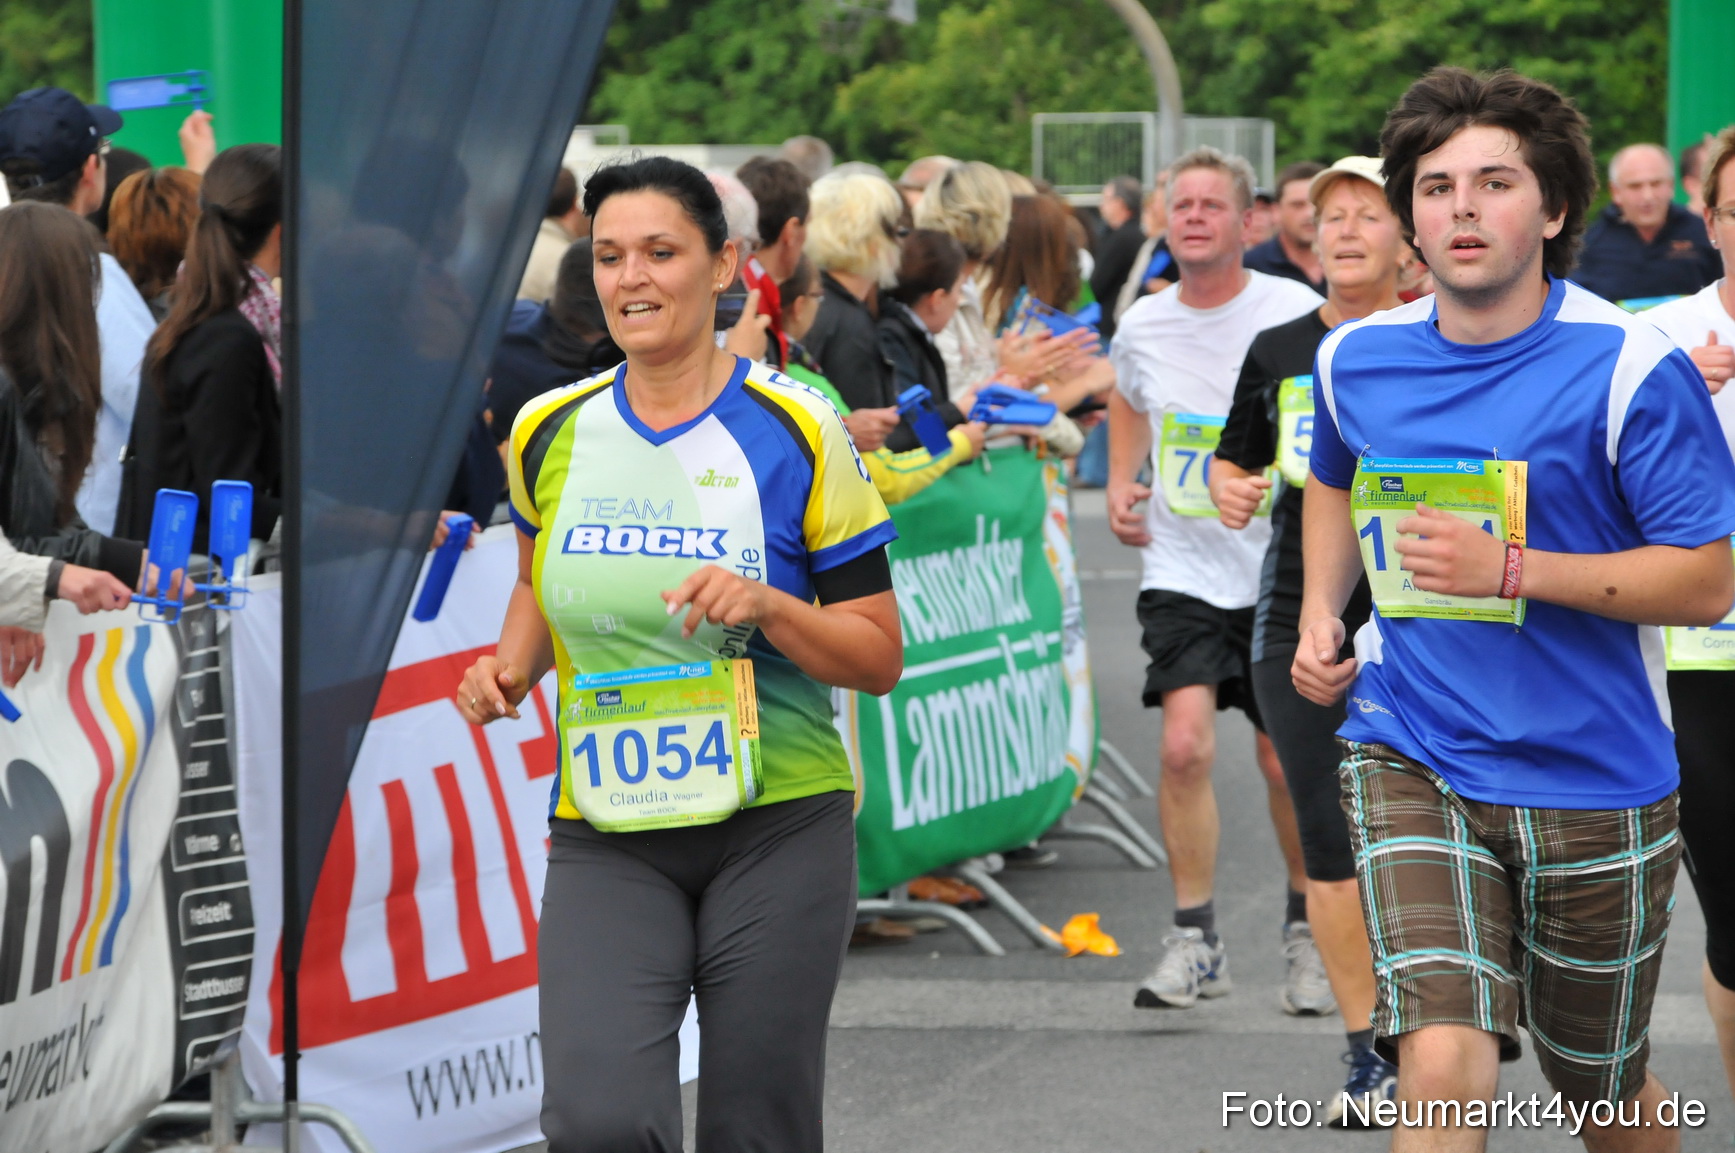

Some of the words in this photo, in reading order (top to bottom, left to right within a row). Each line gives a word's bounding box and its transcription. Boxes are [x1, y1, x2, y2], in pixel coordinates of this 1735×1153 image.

[1370, 489, 1428, 502] firmenlauf
[581, 498, 674, 521] TEAM
[561, 524, 729, 560] BOCK
[892, 513, 1032, 647] eumarkter
[585, 700, 647, 718] firmenlauf
[573, 720, 733, 788] 1054
[609, 789, 669, 807] Claudia
[672, 791, 704, 801] Wagner
